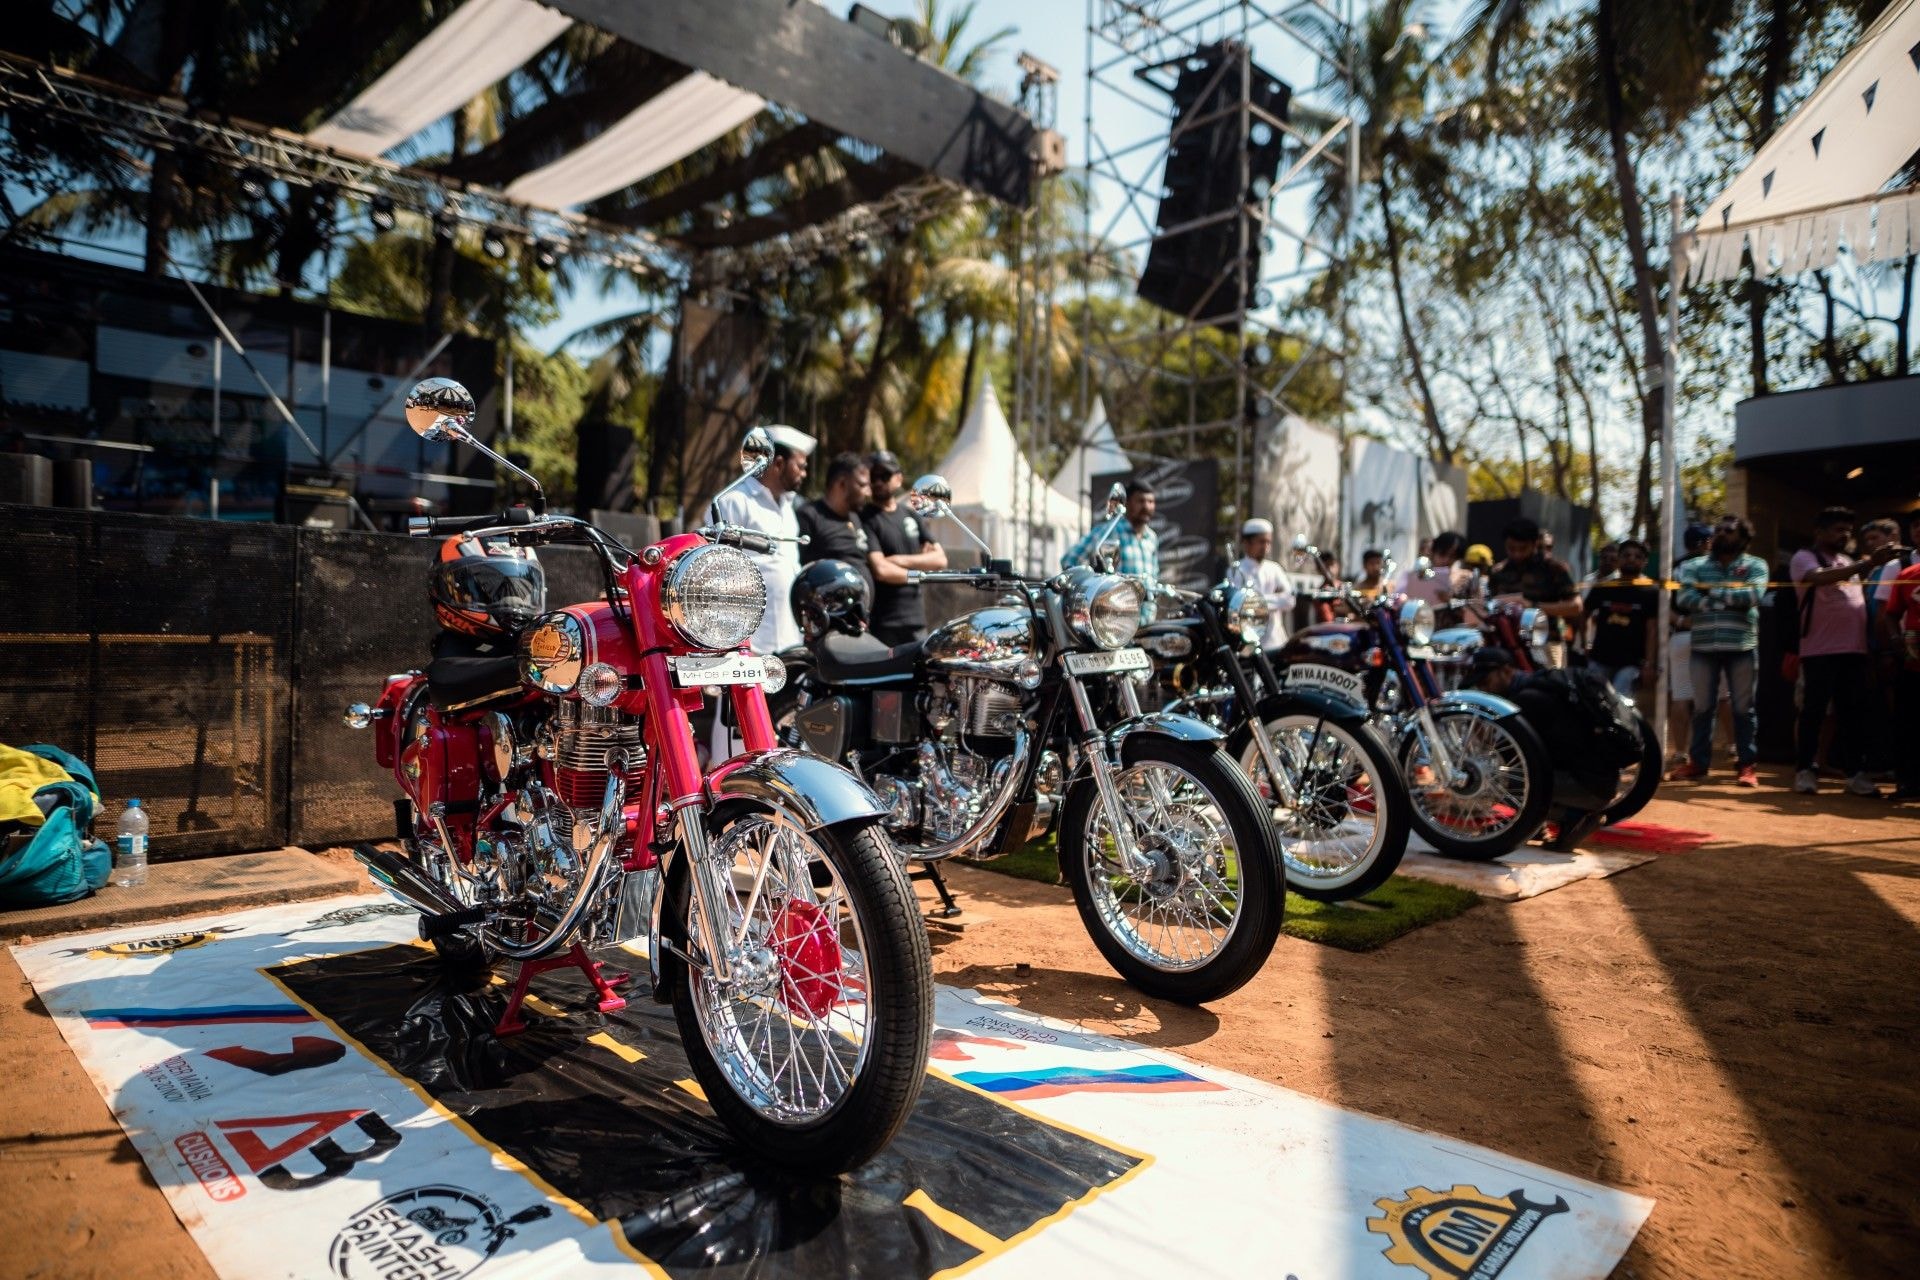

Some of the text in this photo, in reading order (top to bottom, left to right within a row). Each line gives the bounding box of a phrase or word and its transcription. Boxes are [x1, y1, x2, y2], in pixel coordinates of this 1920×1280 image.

[732, 669, 761, 678] 9181
[1072, 658, 1087, 670] MH
[1119, 652, 1144, 665] 4595
[176, 1073, 214, 1102] MANIA
[178, 1134, 242, 1200] CUSHIONS
[369, 1206, 461, 1280] SHASHI
[1428, 1209, 1498, 1256] OM
